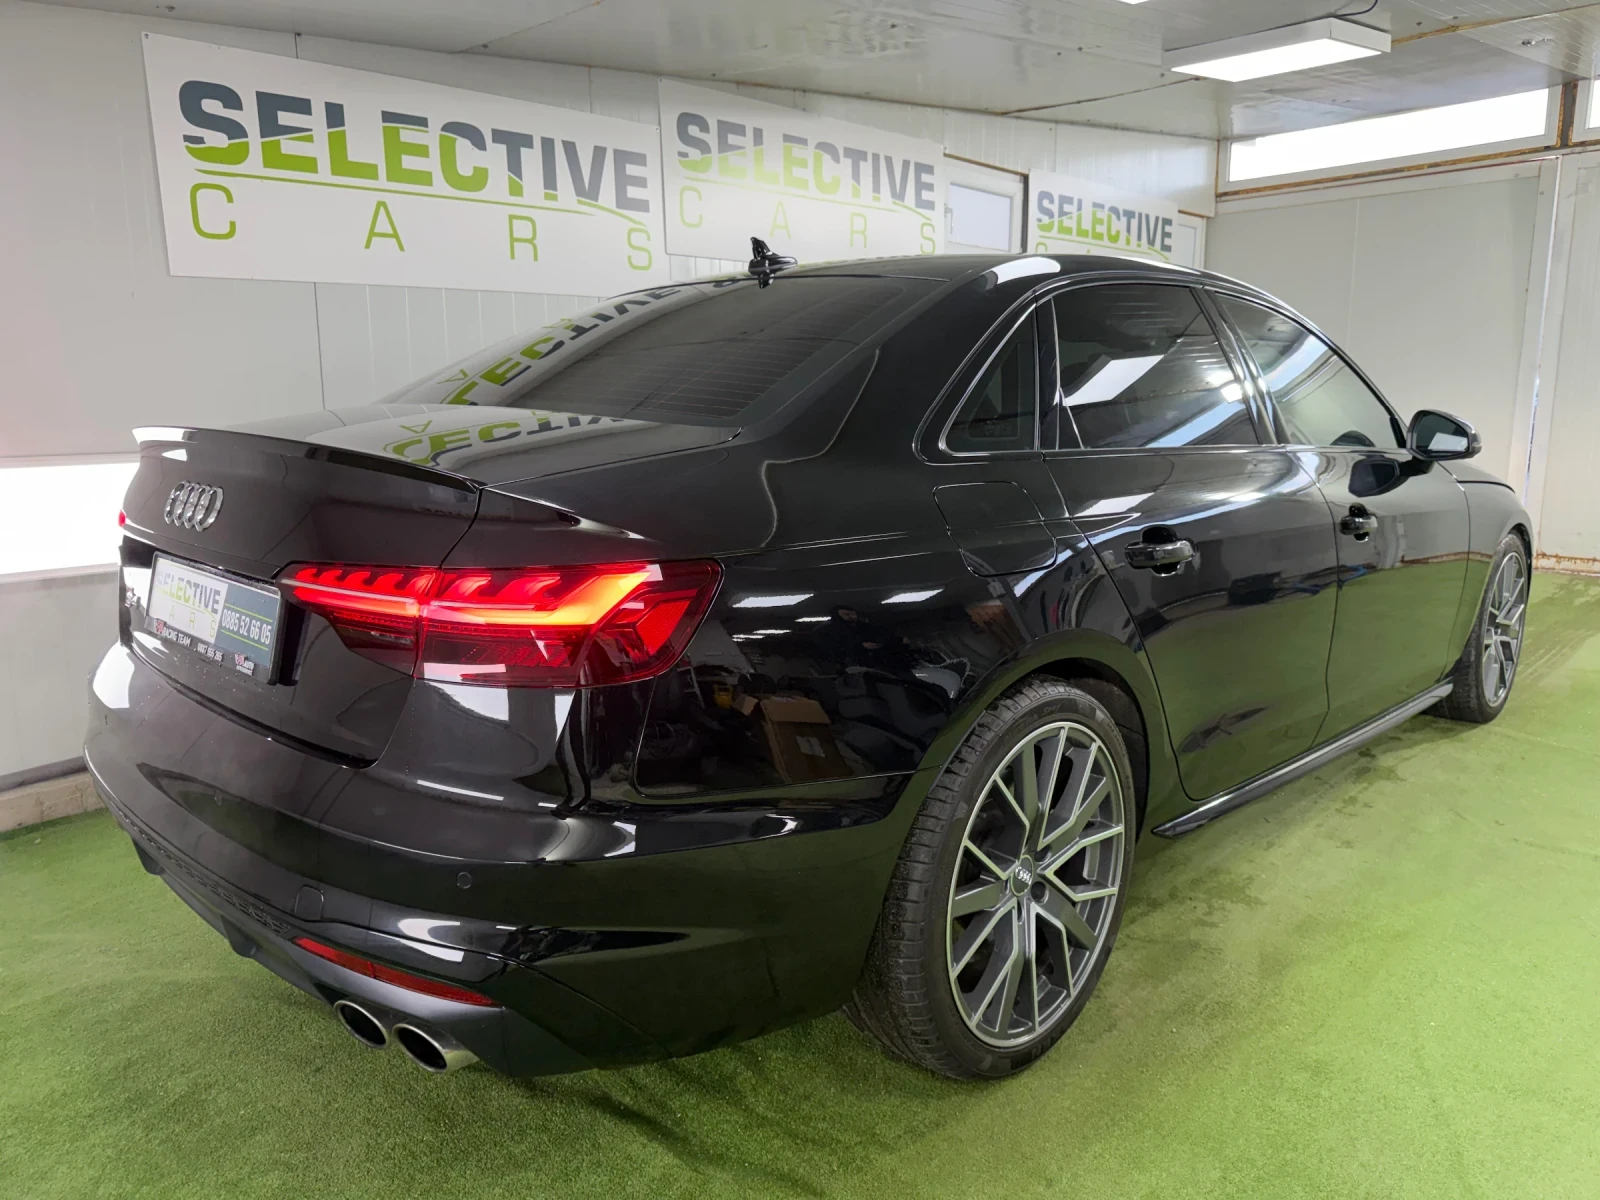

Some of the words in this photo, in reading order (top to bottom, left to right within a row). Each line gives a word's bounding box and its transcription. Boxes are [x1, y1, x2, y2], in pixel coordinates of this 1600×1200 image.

[178, 79, 651, 214] SELECTIVE
[676, 111, 936, 211] SELECTIVE
[189, 183, 653, 271] CARS
[679, 185, 936, 256] CARS
[1036, 190, 1173, 253] SELECTIVE
[177, 632, 192, 647] TEAM
[221, 608, 238, 632] 0885
[239, 615, 250, 636] 52
[249, 619, 261, 641] 66
[260, 624, 272, 645] 05
